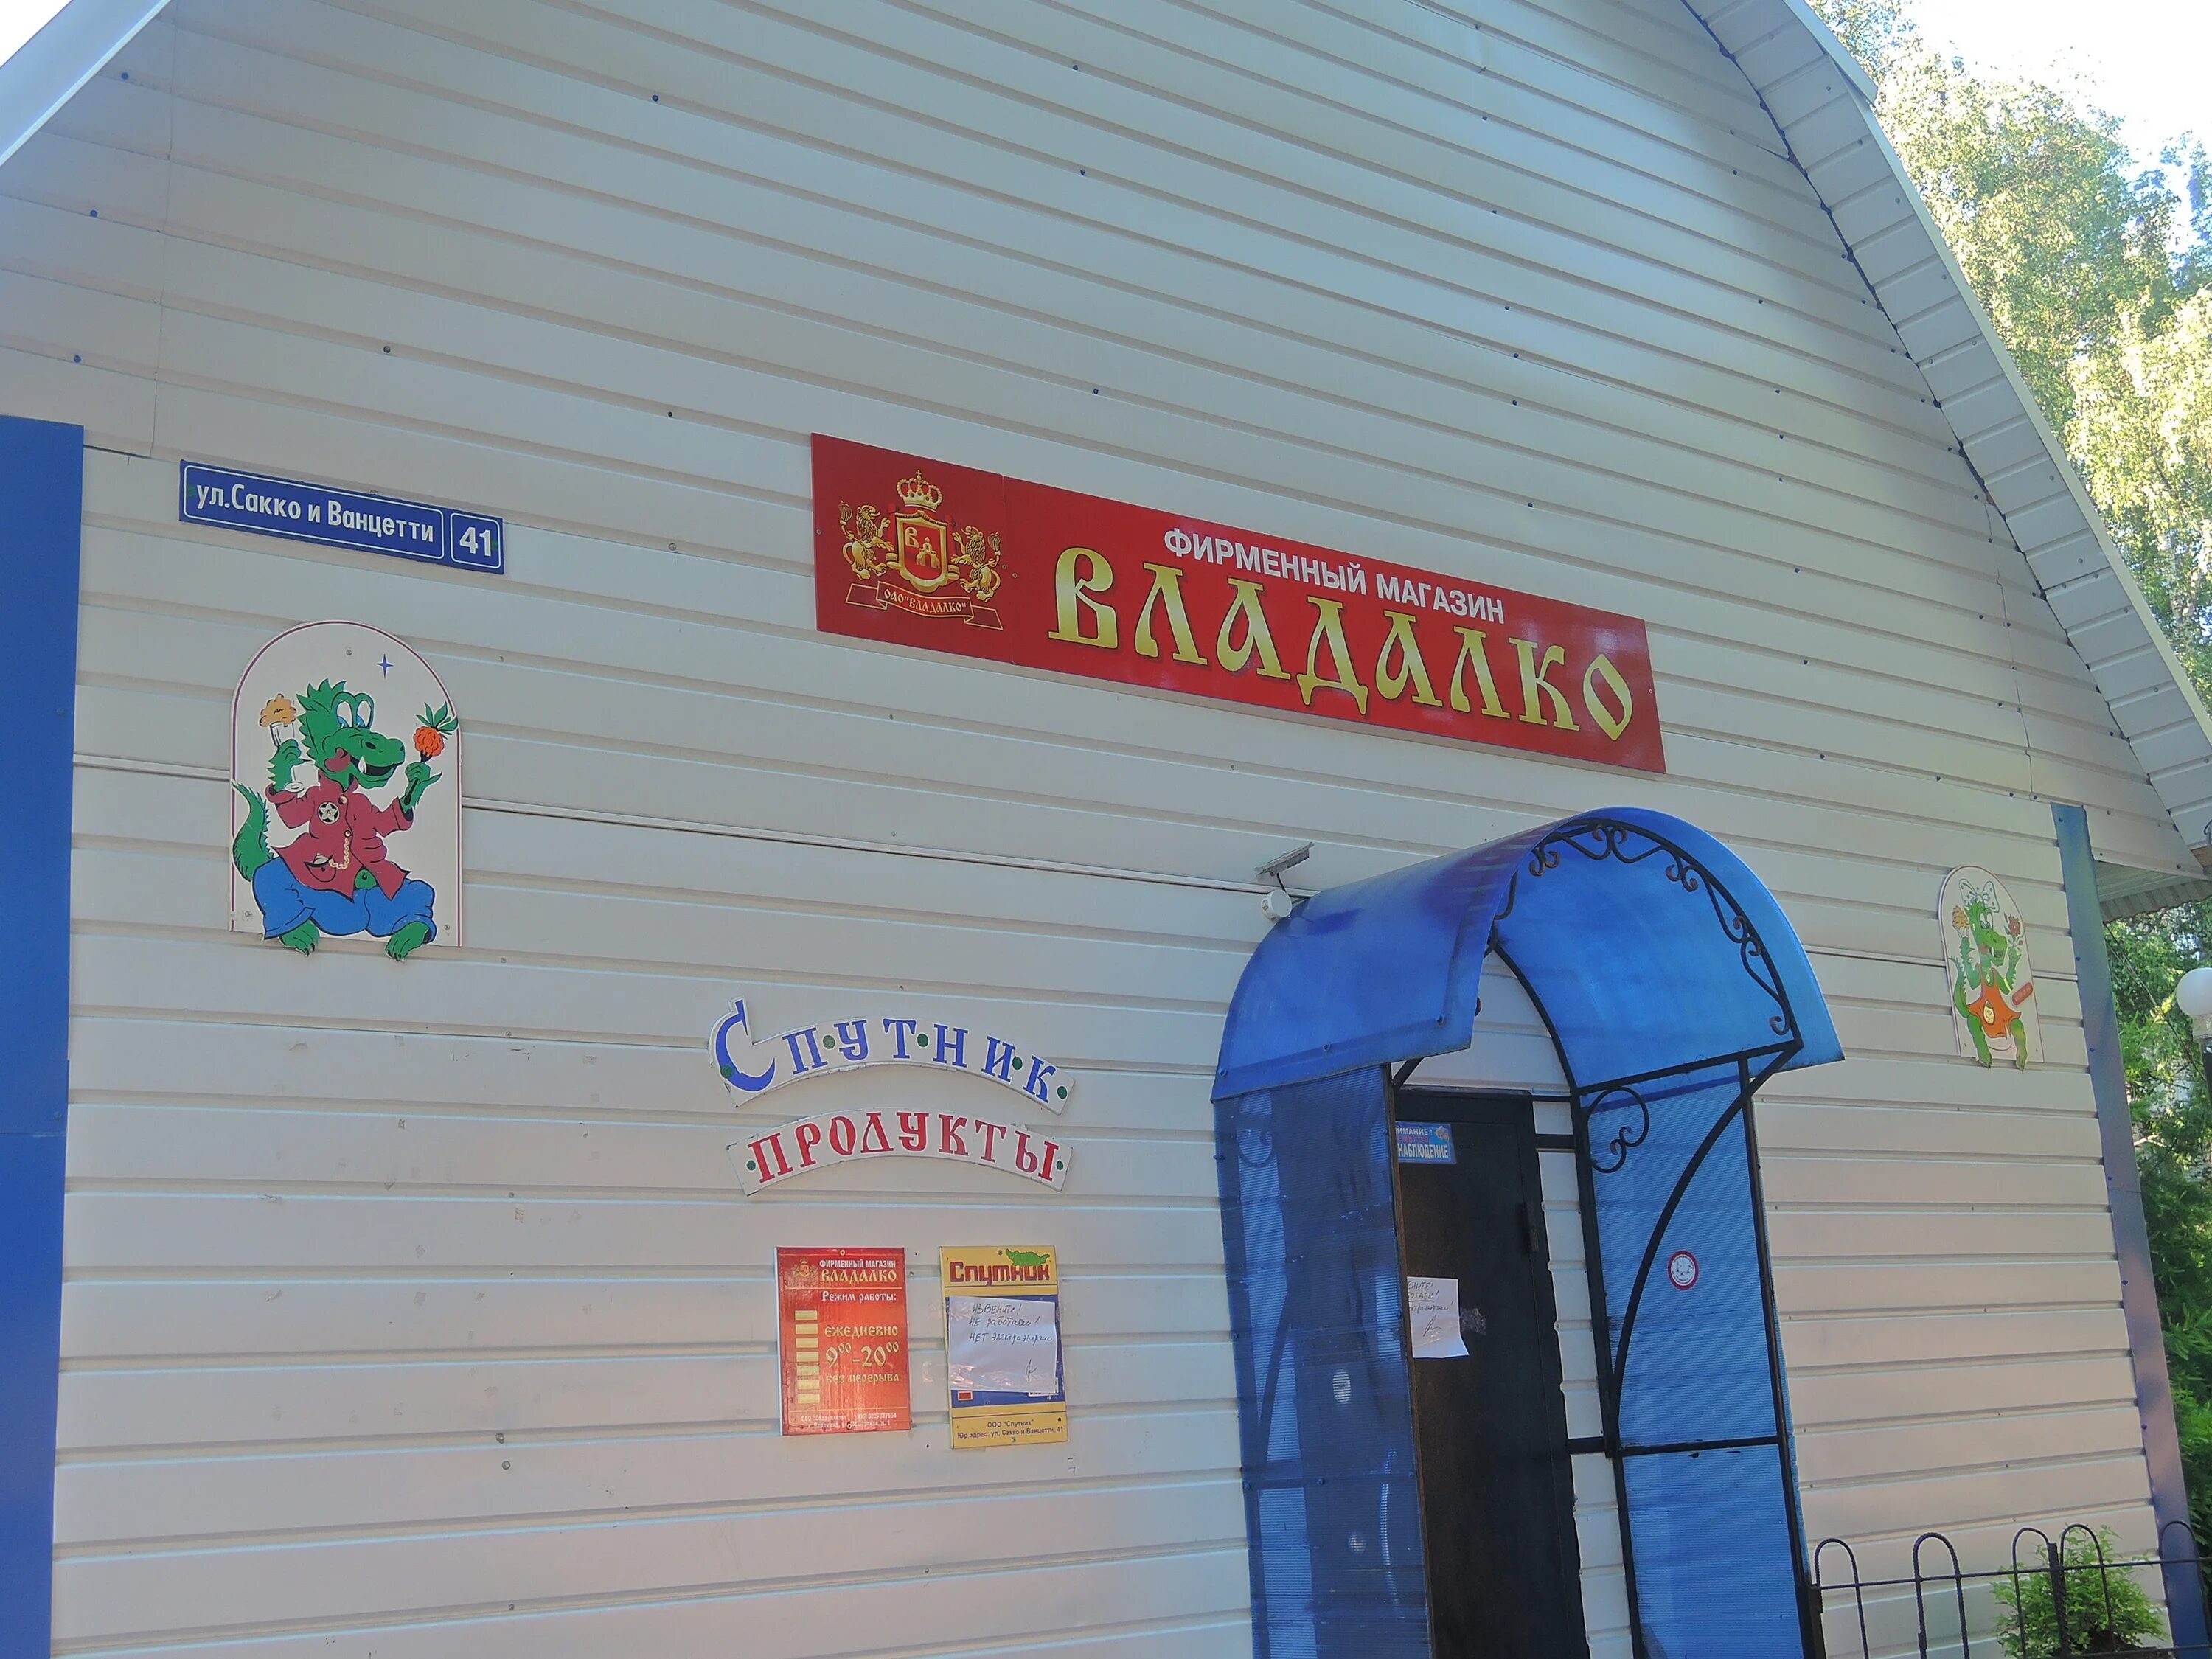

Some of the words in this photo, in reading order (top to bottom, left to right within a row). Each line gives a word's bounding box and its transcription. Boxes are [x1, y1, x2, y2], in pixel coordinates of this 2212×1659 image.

[307, 502, 321, 524] и
[327, 499, 434, 543] Ванцетти
[459, 526, 493, 557] 41
[1163, 527, 1367, 596] ФИРМЕННЫЙ
[1374, 572, 1505, 625] МАГАЗИН
[1047, 546, 1634, 741] ВЛАДАЛКО
[747, 1111, 1060, 1184] ПРОДУКТЫ
[1397, 1143, 1449, 1159] НАБЛЮДЕНИЕ
[819, 1259, 864, 1268] ФИРМЕННЫЙ
[865, 1259, 896, 1268] МАГАЗИН
[950, 1261, 1051, 1287] Спутник
[821, 1269, 897, 1284] ВЛАДАЛКО
[822, 1290, 856, 1301] Режим
[859, 1293, 897, 1304] работы:
[969, 1332, 990, 1342] НЕТ
